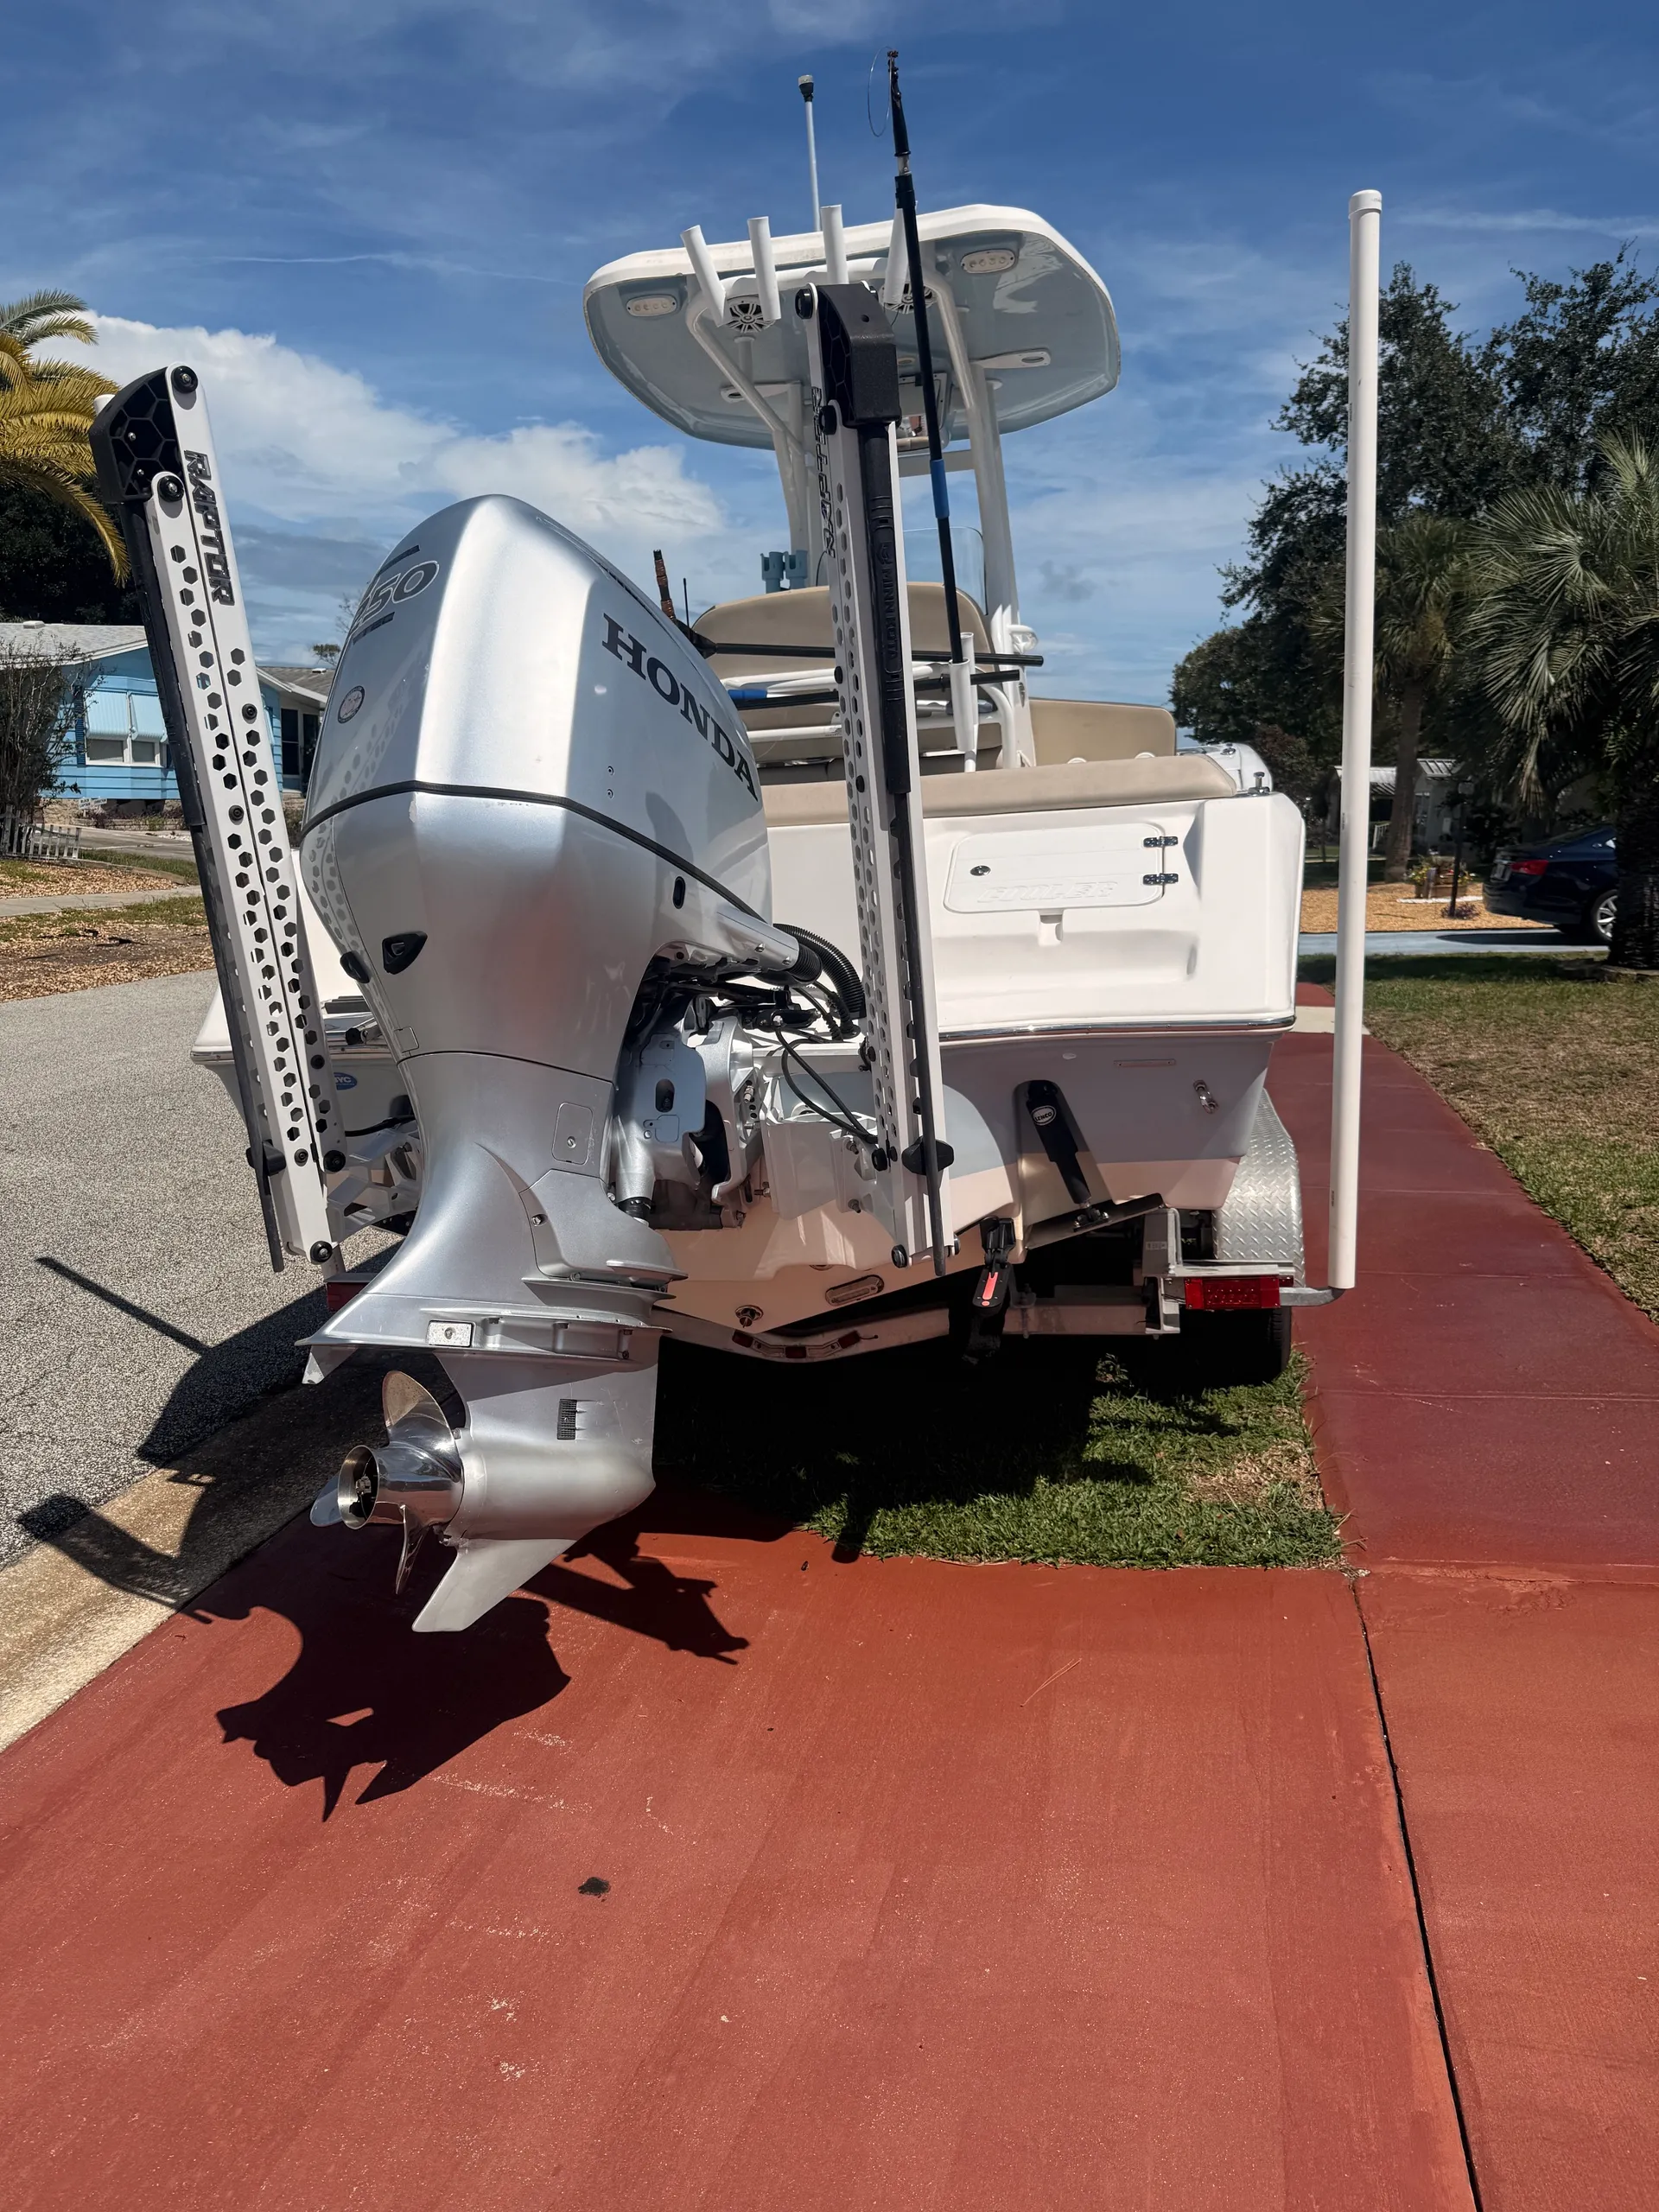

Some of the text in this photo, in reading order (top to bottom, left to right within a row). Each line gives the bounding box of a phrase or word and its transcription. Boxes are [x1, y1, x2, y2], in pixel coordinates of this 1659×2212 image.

[811, 386, 836, 558] RAPTOR
[184, 450, 235, 606] RAPTOR
[346, 560, 439, 638] 250
[882, 568, 895, 613] MINN
[602, 613, 759, 802] HONDA
[977, 881, 1118, 904] COOLER
[1034, 1111, 1052, 1122] LENCO
